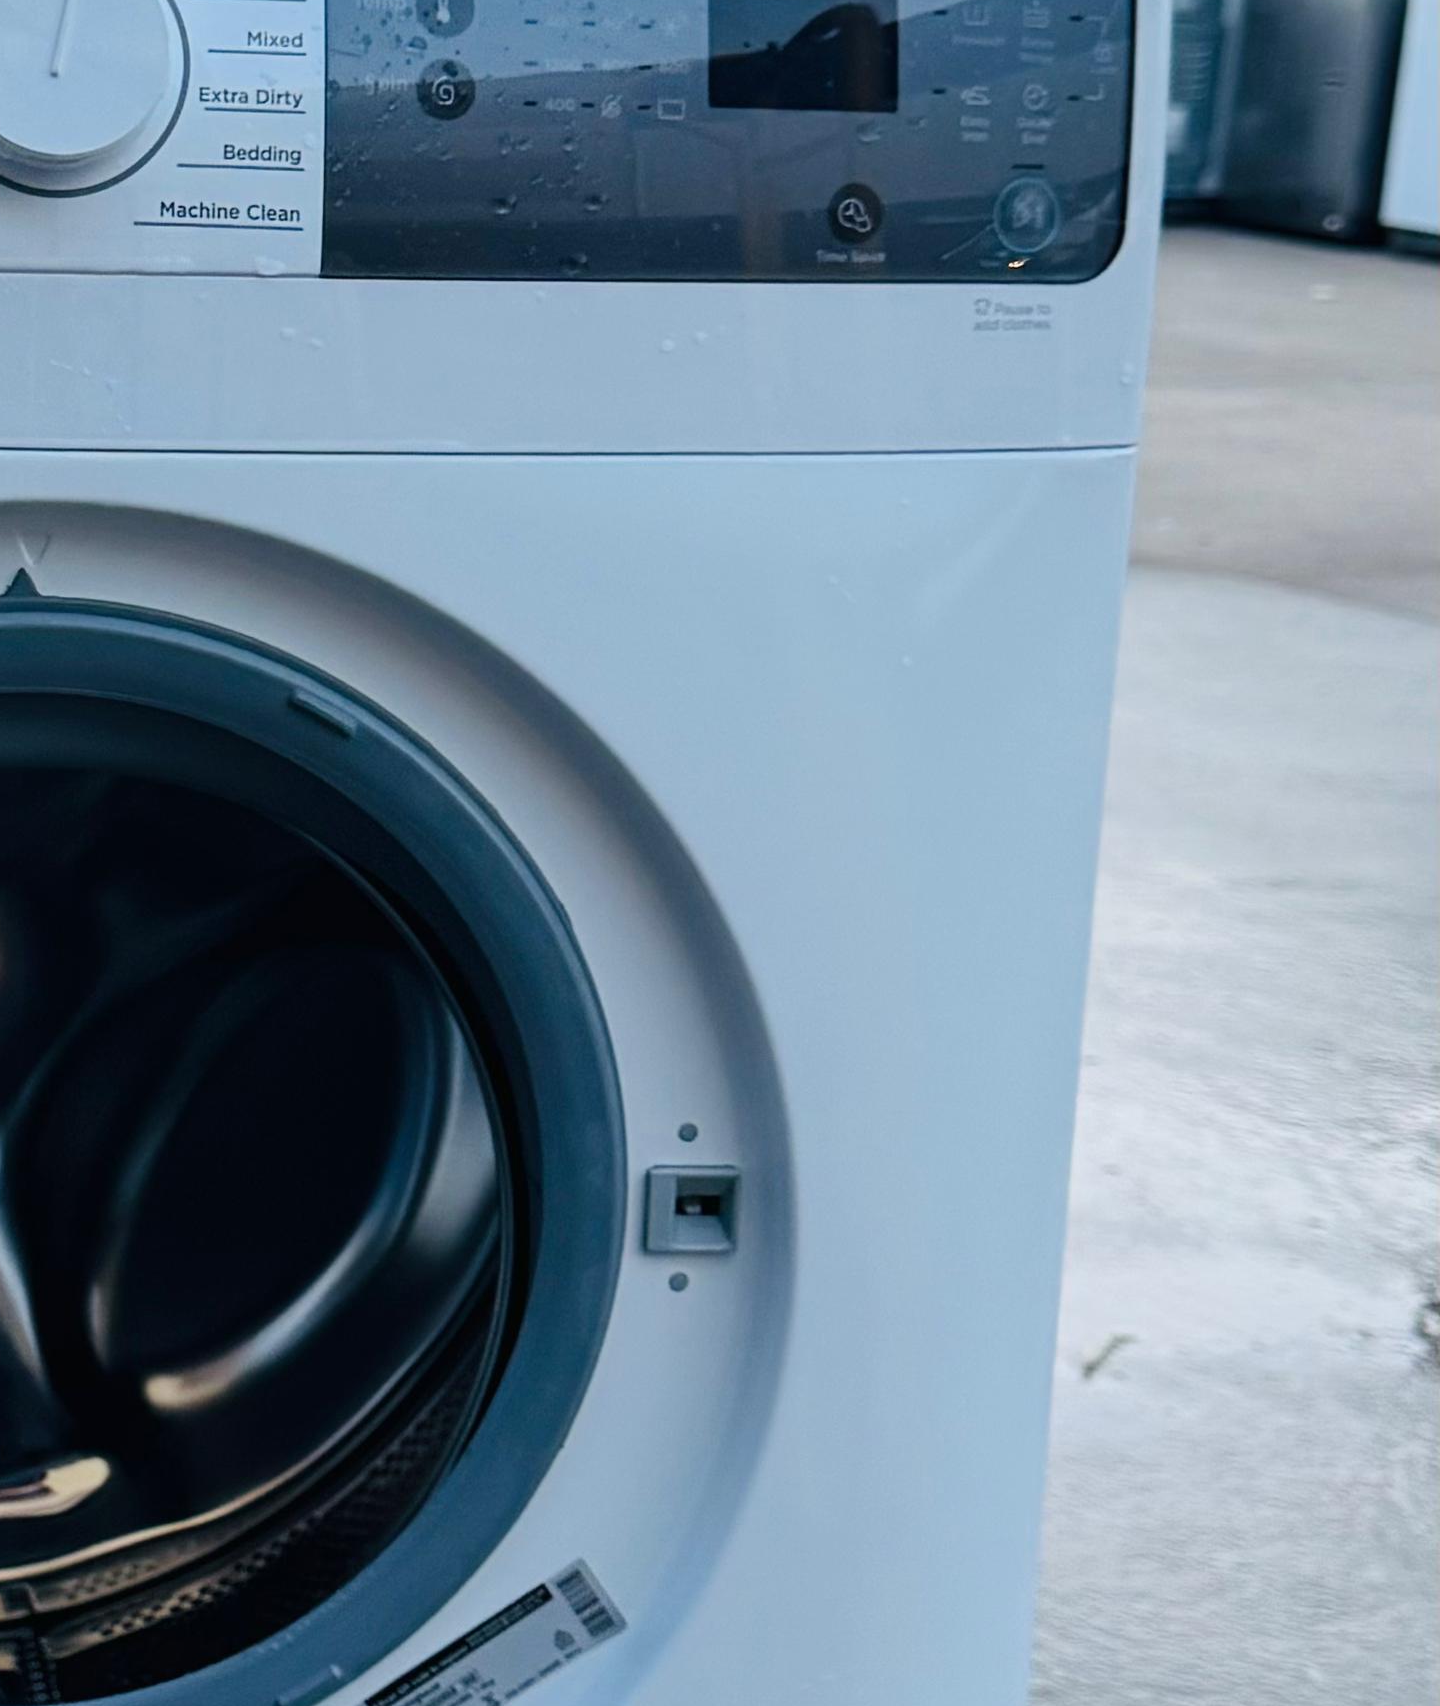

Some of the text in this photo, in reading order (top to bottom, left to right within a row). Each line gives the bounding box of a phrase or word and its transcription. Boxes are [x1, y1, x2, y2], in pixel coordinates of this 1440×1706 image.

[246, 30, 304, 49] Mixed
[198, 86, 304, 109] Extra Dirty
[222, 143, 302, 166] Bedding
[159, 200, 302, 223] Machine Clean
